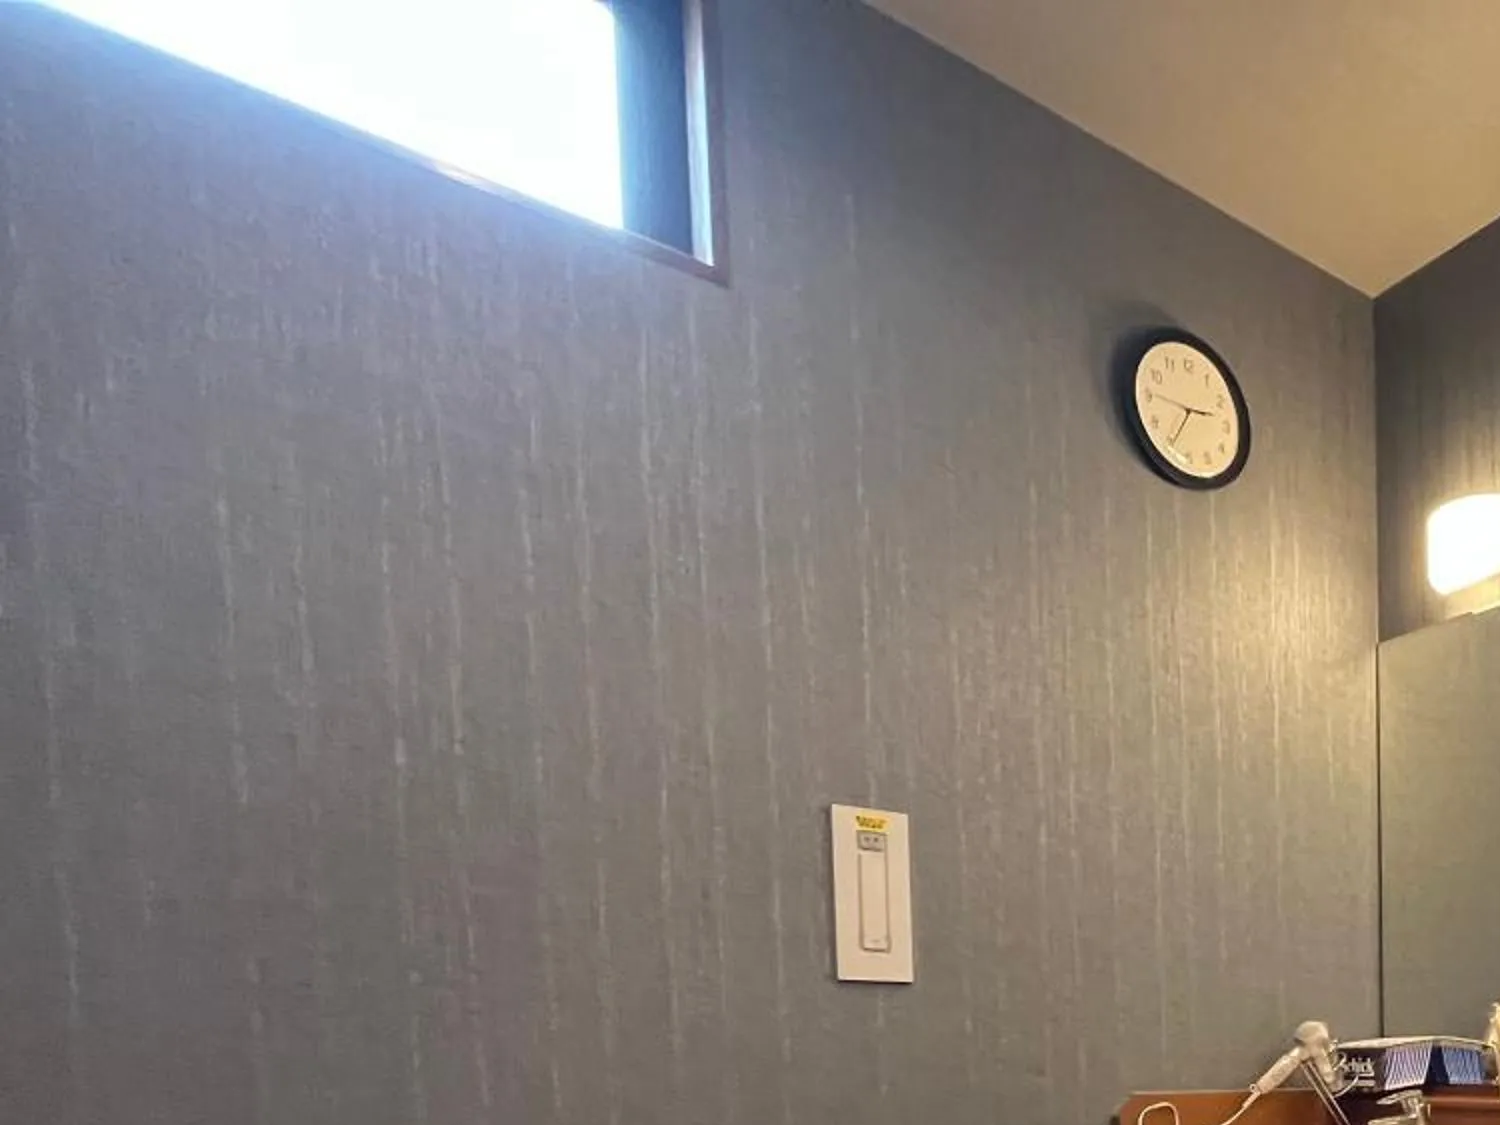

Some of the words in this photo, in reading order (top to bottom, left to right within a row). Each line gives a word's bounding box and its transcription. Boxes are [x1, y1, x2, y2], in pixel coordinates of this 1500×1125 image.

[1164, 355, 1175, 373] 11
[1183, 357, 1194, 374] 12
[1150, 367, 1162, 385] 10
